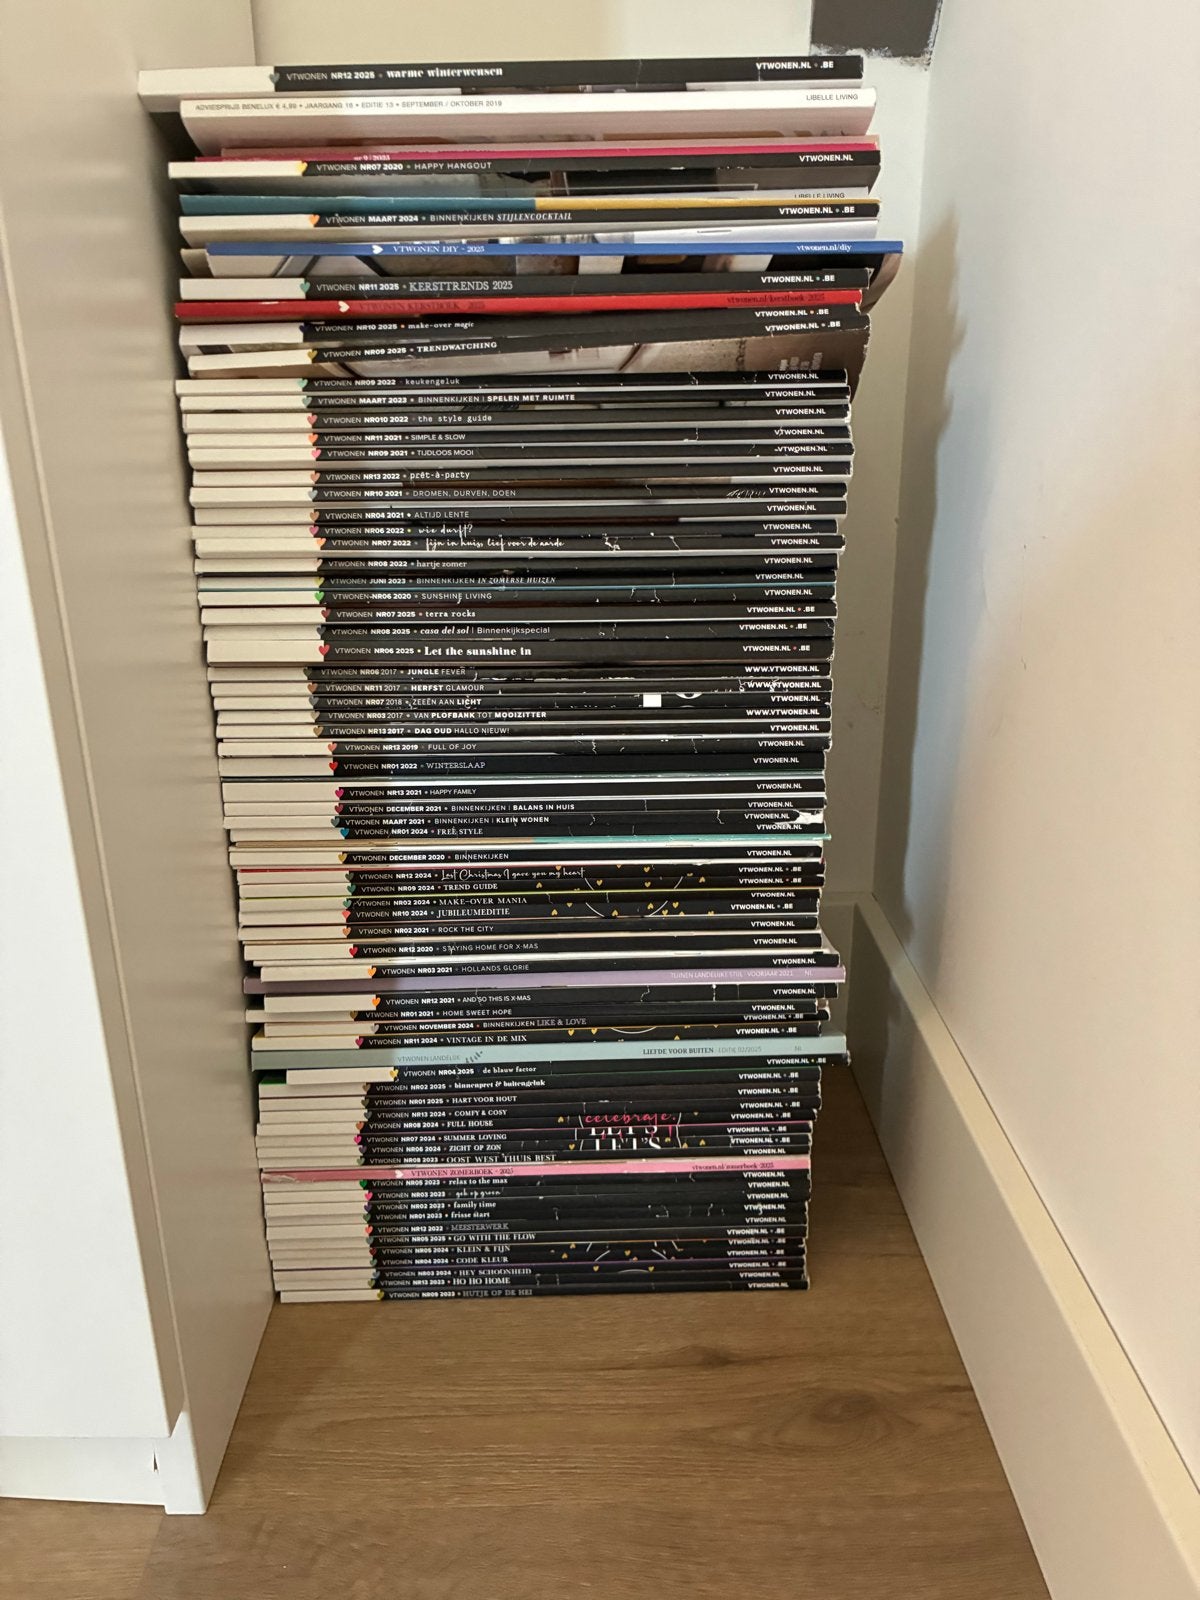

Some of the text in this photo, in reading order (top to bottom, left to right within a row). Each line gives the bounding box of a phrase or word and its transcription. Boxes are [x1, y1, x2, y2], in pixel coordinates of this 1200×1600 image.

[755, 61, 834, 70] VTWONEN.NL .BE
[286, 66, 503, 81] VTWONEN NR12 2025 warme winterwensen
[316, 161, 492, 172] VTWONEN NR07 2020 HAPPY HANGOUT
[779, 206, 855, 215] VTWONEN.NL .BE
[325, 212, 573, 224] VTWONEN MAART 2024 BINNENKIJKEN STIJLENCOCKTAIL
[393, 245, 485, 253] VTWONEN DIY 2025
[797, 243, 852, 252] vtwonen.nl/diy
[761, 275, 814, 284] VTWONEN.NL
[316, 280, 513, 292] VTWONEN NR11 2025 KERSTTRENDS 2025
[755, 309, 808, 318] VTWONEN.NL
[408, 321, 452, 330] make-over
[454, 321, 474, 329] magic
[323, 350, 361, 359] VTWONEN
[364, 348, 385, 356] NR09
[416, 341, 498, 353] TRENDWATCHING
[364, 416, 388, 424] NR010
[417, 414, 433, 423] the
[438, 414, 463, 423] style
[467, 413, 492, 423] guide
[412, 490, 450, 498] DROMEN,
[492, 489, 516, 497] DOEN
[425, 610, 449, 618] terra
[451, 610, 476, 618] rocks
[334, 647, 371, 655] VTWONEN
[424, 646, 442, 656] Let
[446, 646, 463, 656] the
[466, 646, 516, 656] sunshine
[520, 646, 532, 656] in
[431, 711, 475, 719] PLOFBANK
[329, 727, 366, 735] VTWONEN
[414, 727, 432, 735] DAG
[433, 727, 452, 735] OUD
[454, 727, 480, 735] HALLO
[352, 853, 509, 862] VTWONEN DECEMBER 2020 BINNENKIJKEN
[356, 910, 390, 919] VTWONEN
[436, 908, 510, 919] JUBILEUMEDITIE
[358, 928, 392, 936] VTWONEN
[365, 1011, 399, 1019] VTWONEN
[442, 1009, 464, 1017] HOME
[368, 1038, 401, 1046] VTWONEN
[446, 1036, 482, 1044] VINTAGE
[485, 1035, 494, 1043] IN
[497, 1035, 508, 1043] DE
[511, 1034, 527, 1042] MIX
[642, 1048, 667, 1056] LIEFDE
[738, 1072, 781, 1080] VTWONEN.NL
[453, 1201, 477, 1209] family
